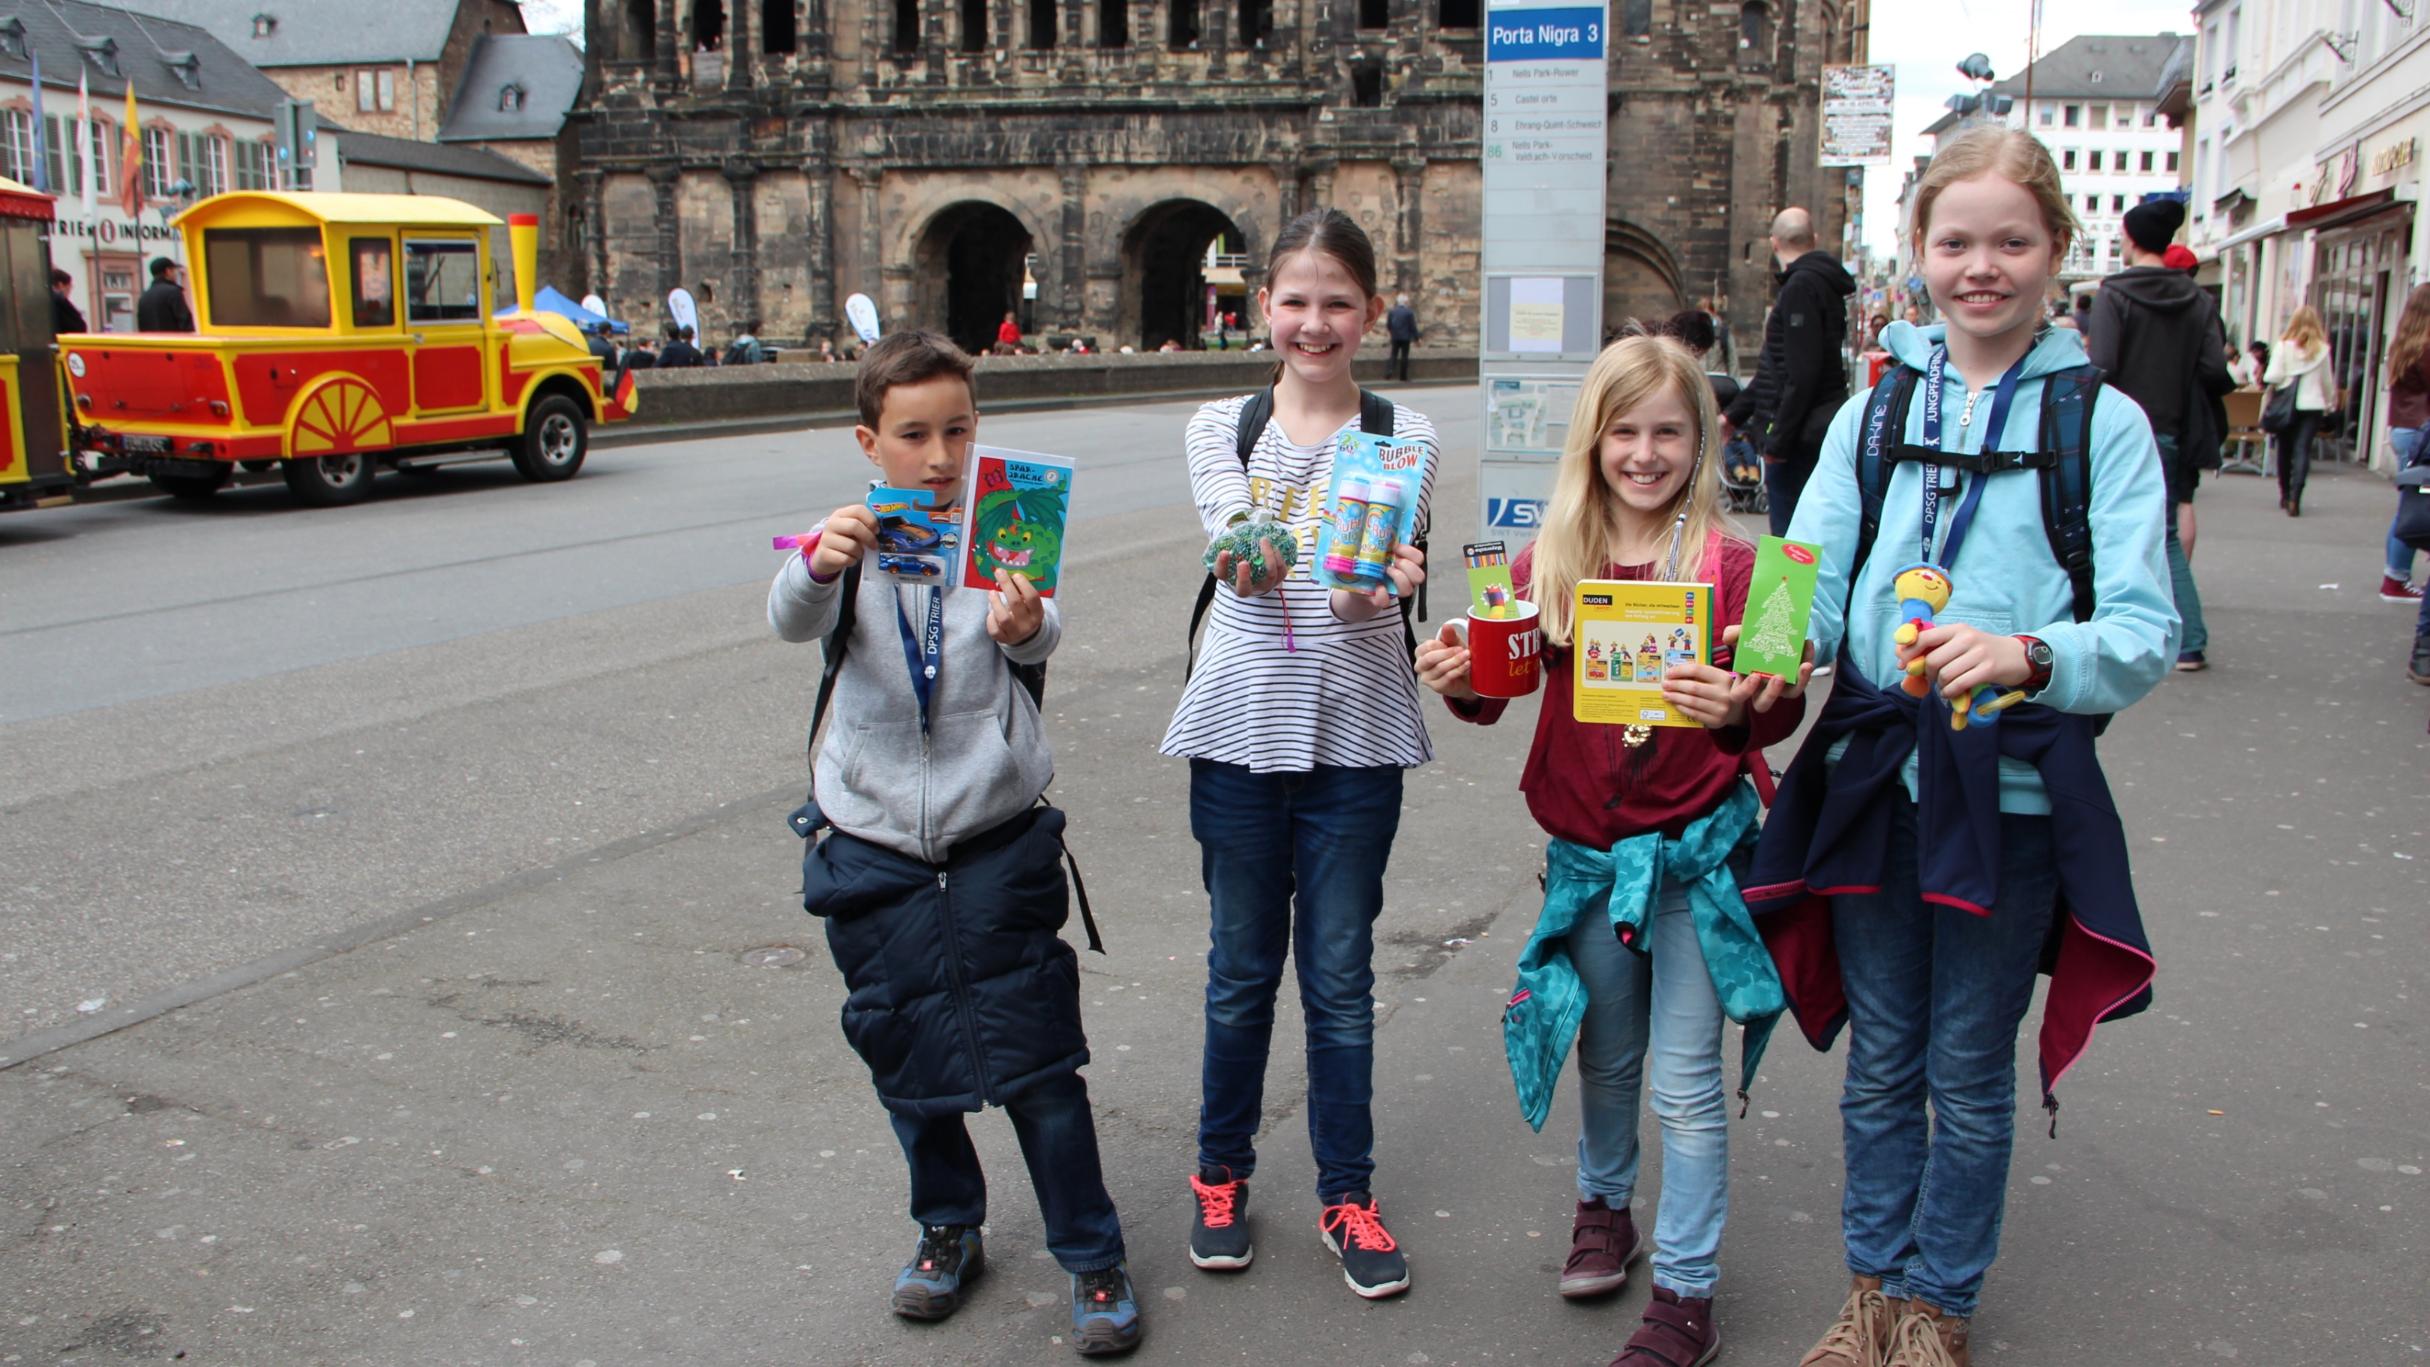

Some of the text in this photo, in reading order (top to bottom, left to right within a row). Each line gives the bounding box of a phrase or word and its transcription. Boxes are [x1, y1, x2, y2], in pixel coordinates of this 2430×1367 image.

[1492, 23, 1599, 47] Porta Nigra 3
[1488, 69, 1493, 81] 1
[1490, 94, 1498, 106] 5
[1490, 120, 1498, 133] 8
[1487, 145, 1503, 158] 86
[1866, 404, 1888, 457] DAKINE
[1379, 445, 1424, 462] BUBBLE
[1383, 454, 1418, 470] BLOW
[1924, 491, 1936, 525] DPSG
[926, 596, 940, 655] DPSG TRIER
